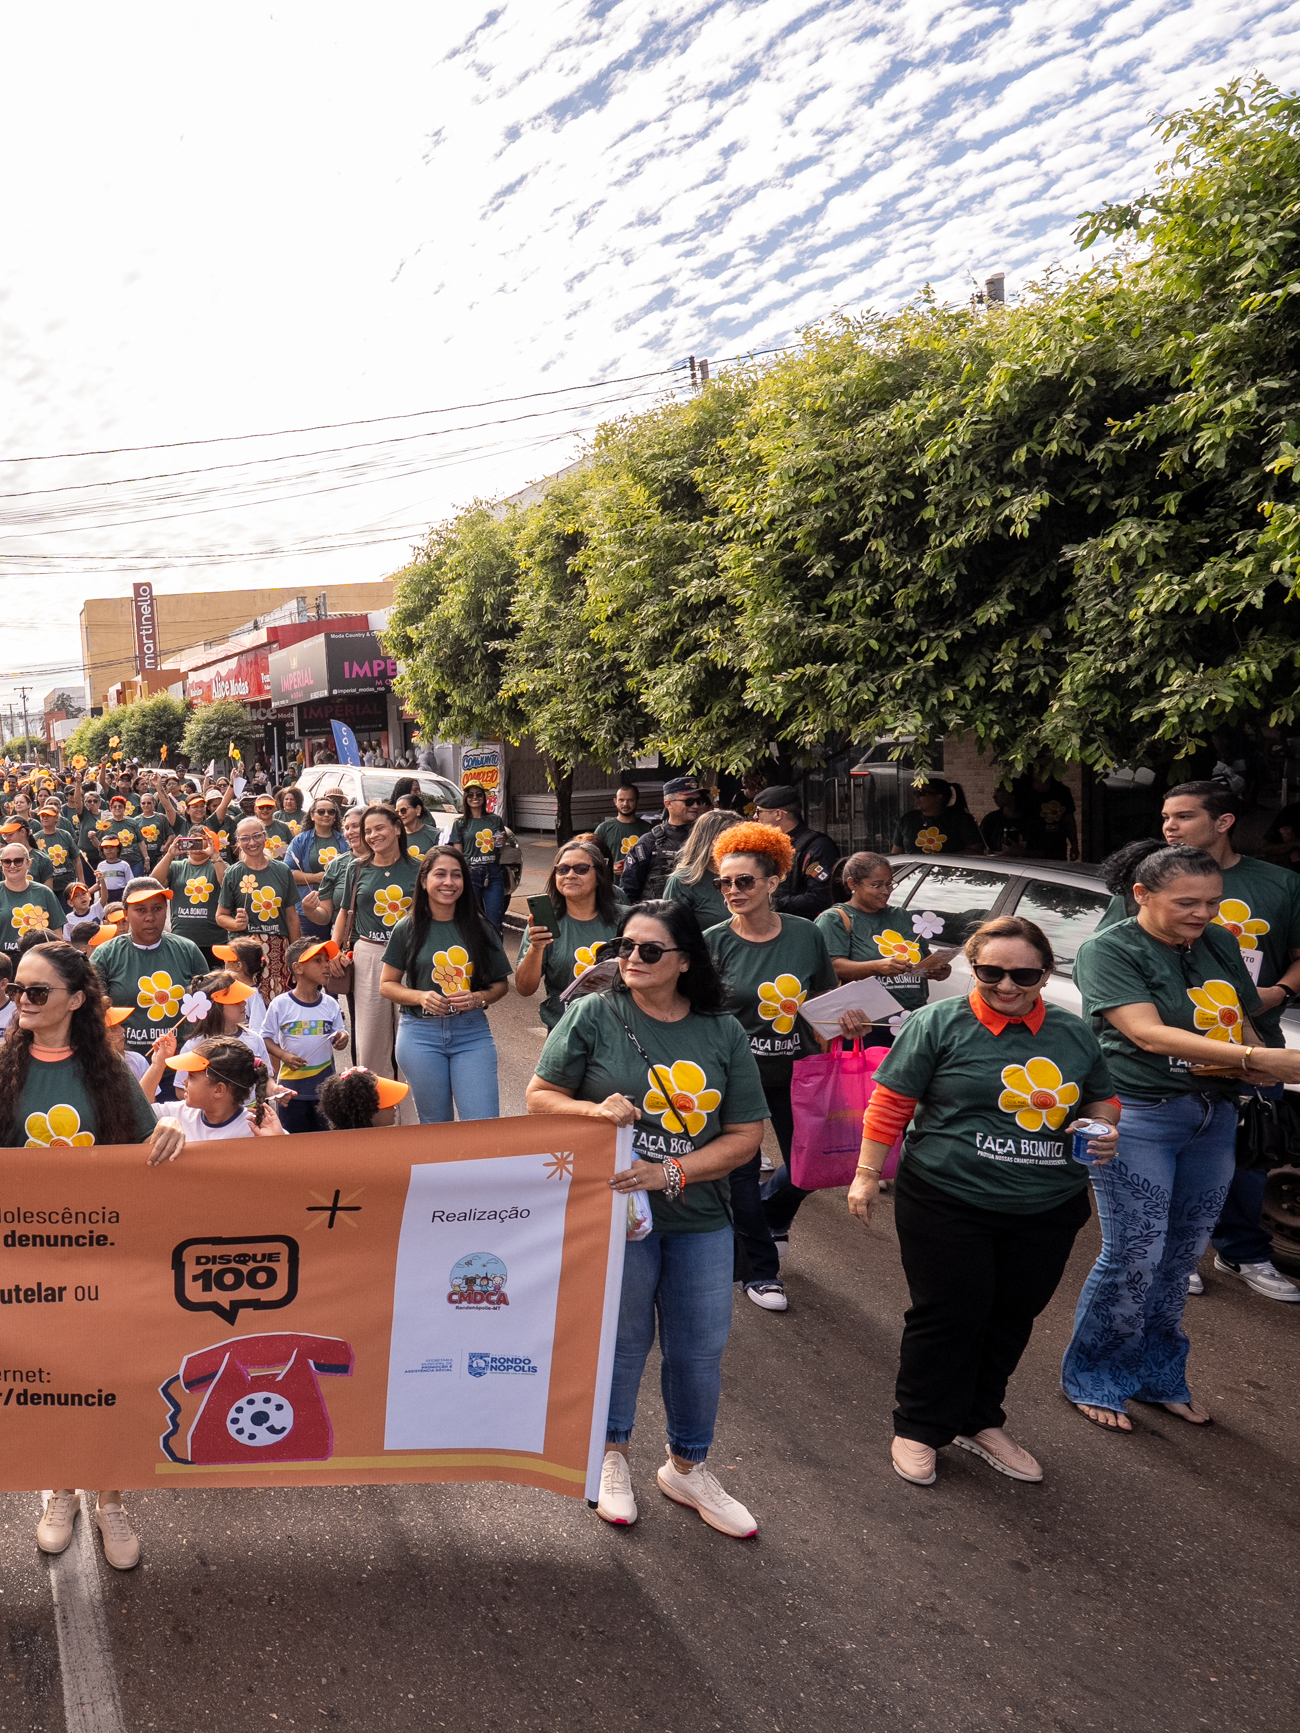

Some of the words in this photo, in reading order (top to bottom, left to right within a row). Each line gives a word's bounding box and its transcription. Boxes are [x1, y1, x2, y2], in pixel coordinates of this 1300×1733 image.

[139, 584, 157, 669] martinello
[344, 659, 397, 679] IMPE
[212, 676, 230, 699] Alice
[230, 677, 249, 696] Modas
[281, 667, 314, 692] IMPERIAL
[302, 702, 382, 719] IMPERIAL
[874, 976, 893, 986] AÇA
[126, 1027, 148, 1041] FAÇA
[149, 1027, 178, 1040] BONO
[976, 1132, 1016, 1155] FAÇA
[1020, 1139, 1064, 1158] BONITO
[994, 1154, 1013, 1163] NOSSAS
[1013, 1157, 1034, 1165] CRIANÇAS
[431, 1206, 531, 1224] Realização
[3, 1230, 115, 1248] denuncie.
[195, 1252, 281, 1268] DISQUE
[191, 1265, 278, 1293] 100
[74, 1284, 99, 1301] ou
[447, 1290, 510, 1306] CMDCA
[490, 1357, 532, 1366] RONDO
